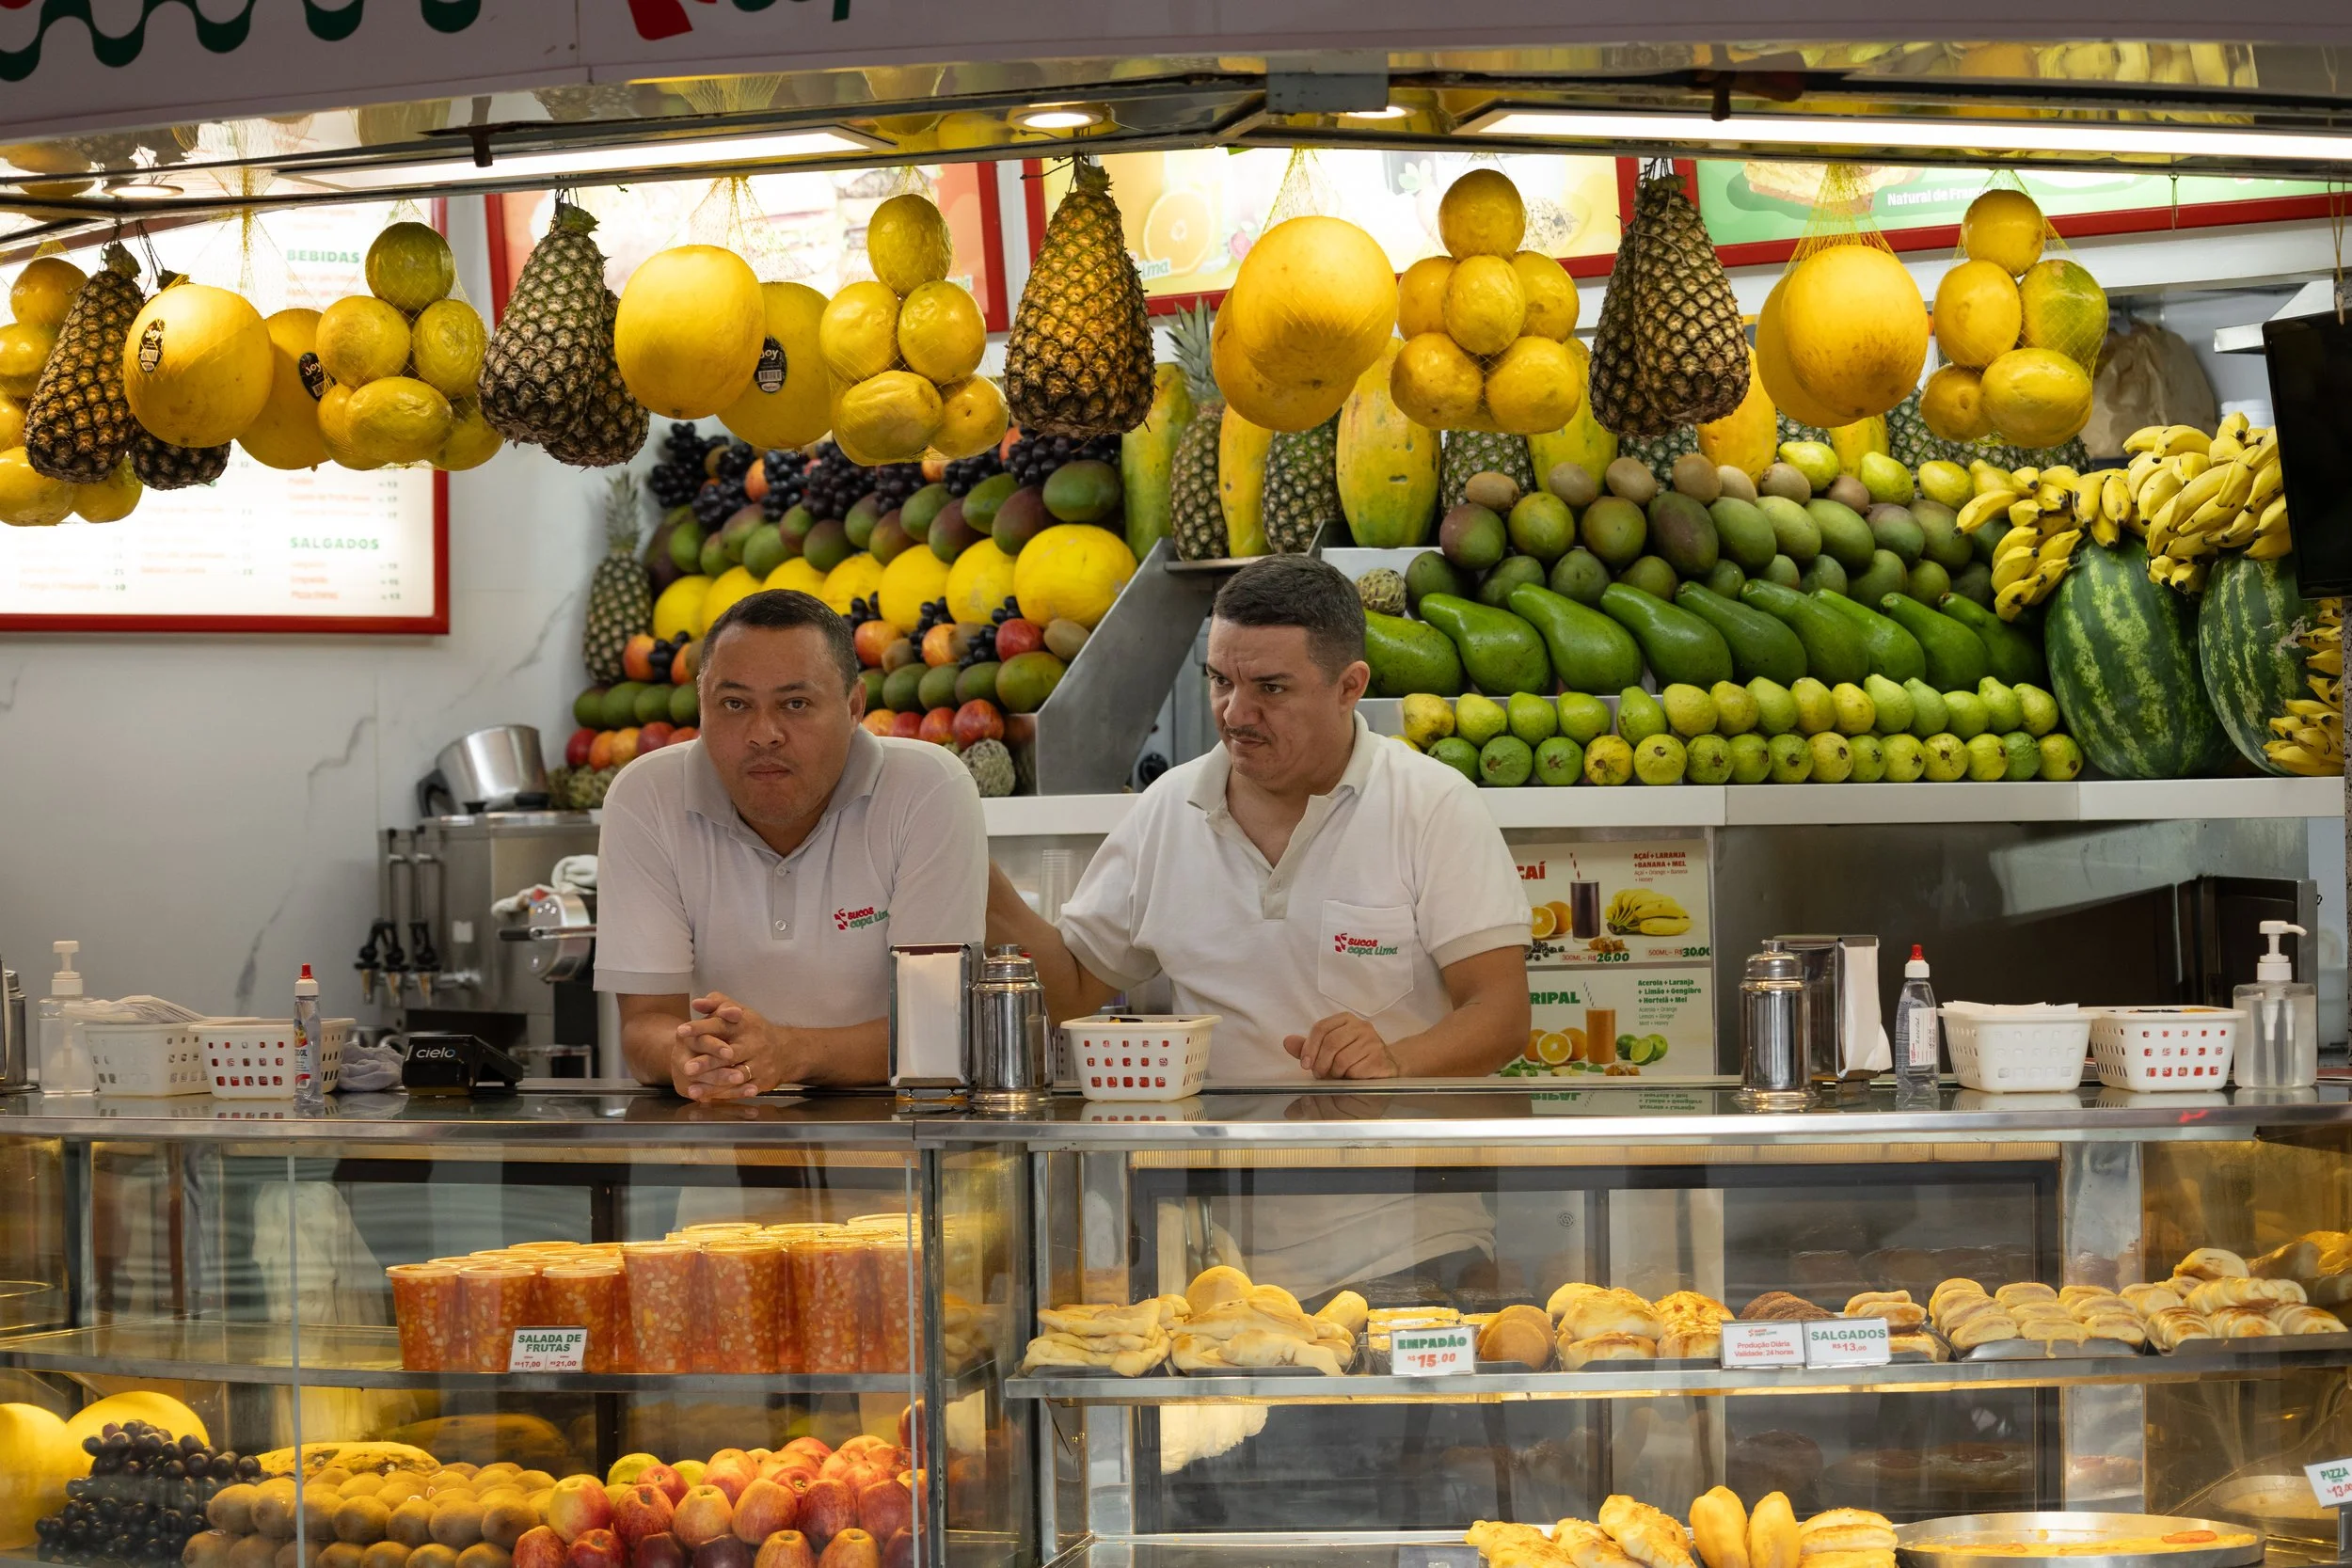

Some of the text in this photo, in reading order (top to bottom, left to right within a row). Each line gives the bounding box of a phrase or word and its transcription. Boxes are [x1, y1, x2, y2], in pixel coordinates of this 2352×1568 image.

[1887, 191, 1932, 206] Natural
[1933, 190, 1948, 201] de
[287, 249, 360, 264] BEBIDAS
[290, 537, 379, 550] SALGADOS
[1656, 851, 1686, 860] LARANJA
[848, 907, 874, 920] sucos
[1347, 938, 1378, 947] sucos
[1347, 946, 1373, 957] copa
[1669, 978, 1694, 987] Laranja
[416, 1047, 455, 1058] cielo
[518, 1334, 581, 1343] SALADA DE
[1811, 1329, 1886, 1341] SALGADOS
[1397, 1334, 1467, 1350] EMPADÃO
[526, 1343, 570, 1353] FRUTAS
[2320, 1466, 2350, 1481] PIZZA
